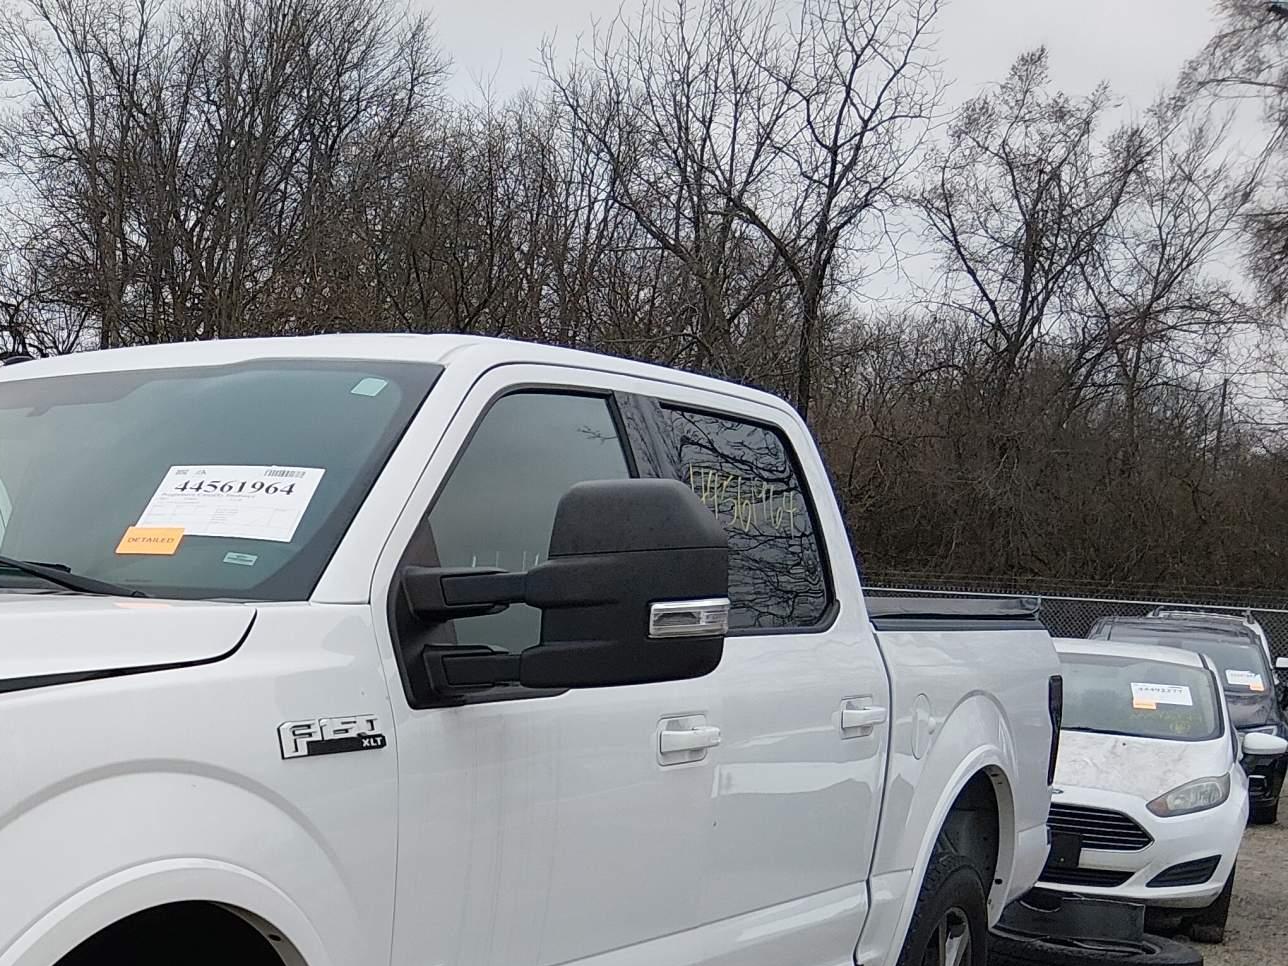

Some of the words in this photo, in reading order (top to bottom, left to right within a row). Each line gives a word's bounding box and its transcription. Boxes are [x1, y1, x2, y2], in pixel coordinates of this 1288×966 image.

[174, 480, 296, 496] 44561964
[127, 536, 175, 544] DETAILED
[362, 737, 383, 747] XLT
